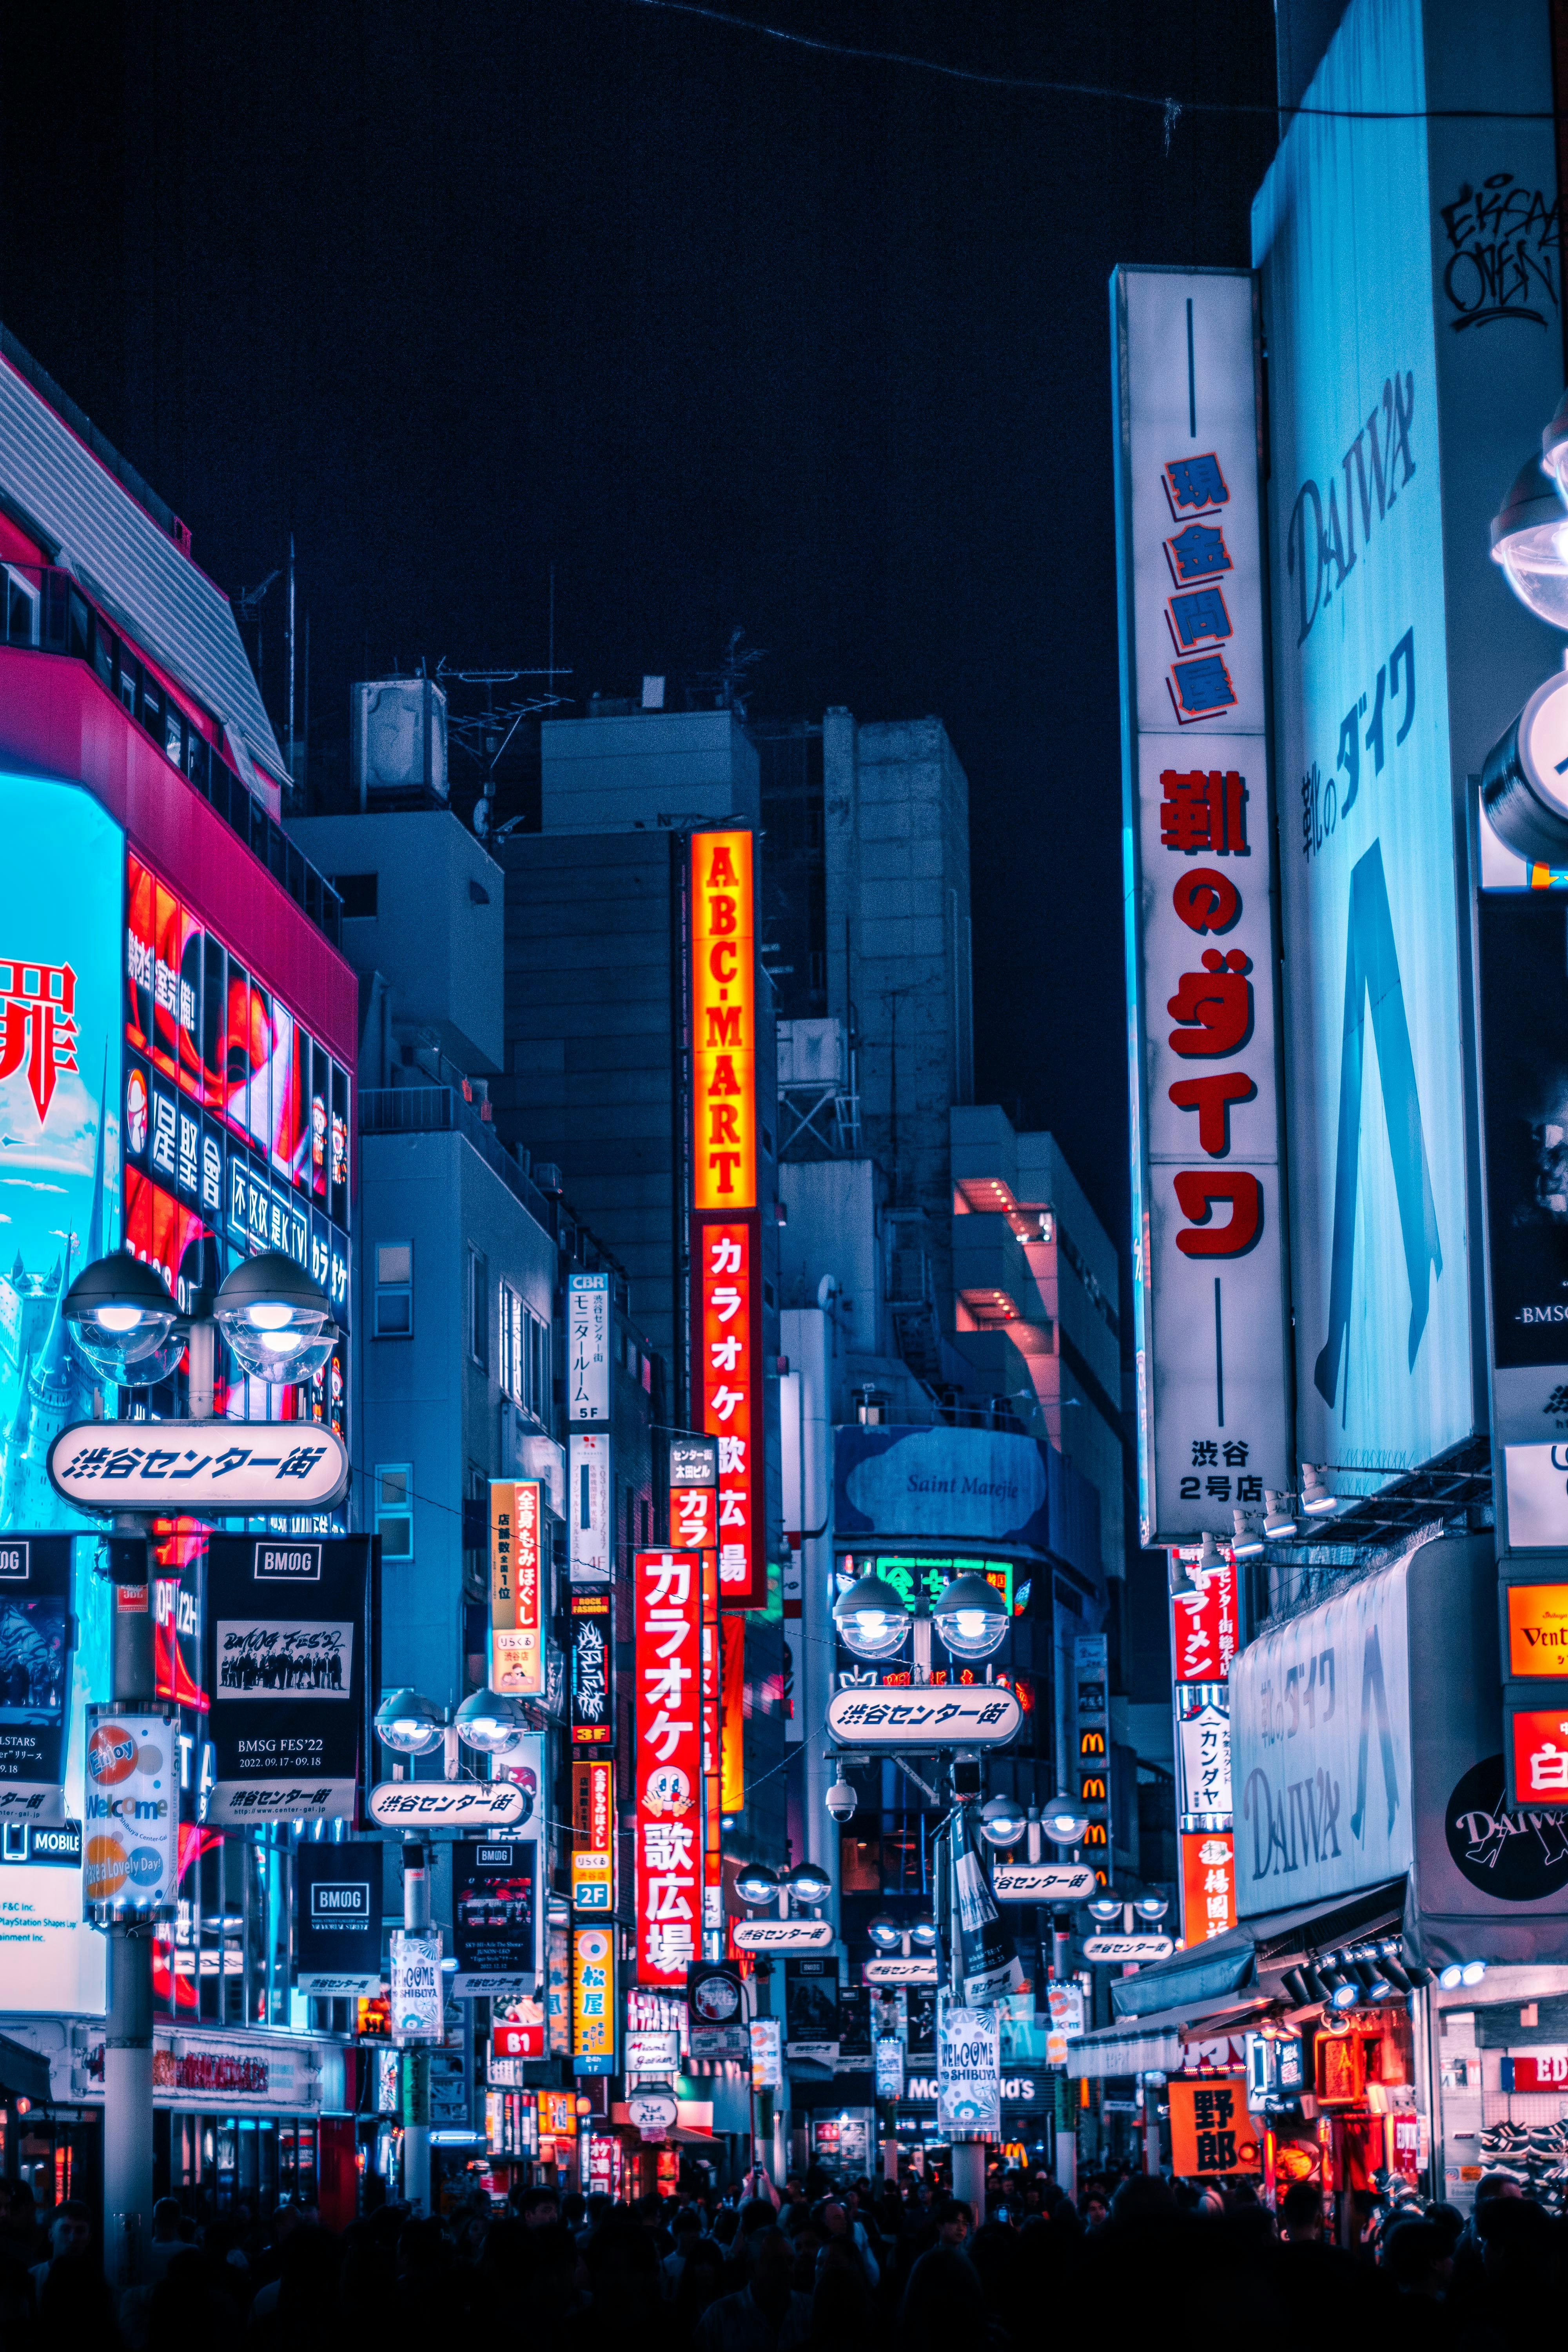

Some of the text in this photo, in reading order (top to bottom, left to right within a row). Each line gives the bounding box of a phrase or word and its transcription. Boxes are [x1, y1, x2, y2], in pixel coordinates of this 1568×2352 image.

[1288, 370, 1416, 649] DAIWA
[1302, 626, 1416, 864] 靴のダイワ
[706, 847, 742, 1194] ABC-MART
[1159, 769, 1264, 1260] 靴のダイワ
[312, 1235, 347, 1303] カラオケ
[573, 1276, 604, 1289] CBR
[593, 1295, 603, 1363] 渋谷センター街
[574, 1295, 590, 1401] モニタールーム
[710, 1238, 747, 1582] カラオケ歌広場
[62, 1446, 327, 1480] 渋谷センター街
[673, 1450, 713, 1461] センター街
[1192, 1440, 1249, 1467] 渋谷
[675, 1464, 711, 1479] 太田ビル
[907, 1474, 956, 1494] Saint
[1180, 1475, 1263, 1502] 2号店
[517, 1490, 536, 1625] 全身もみほぐし
[501, 1637, 532, 1647] りらくる
[504, 1651, 529, 1662] 渋谷店
[1260, 1647, 1334, 1749] 靴のダイワ
[837, 1702, 1011, 1726] 渋谷センター街
[238, 1739, 323, 1753] BMSG FES'22
[576, 1728, 606, 1741] 3F
[88, 1739, 133, 1777] Enjoy
[1201, 1731, 1220, 1805] カンダヤ
[86, 1793, 168, 1820] Welcome
[229, 1788, 332, 1808] 渋谷センター街
[377, 1792, 515, 1812] 渋谷センター街
[119, 1817, 139, 1837] Shibuya
[1243, 1767, 1342, 1881] DAIWA
[35, 1833, 80, 1852] MOBILE
[85, 1857, 162, 1886] Have a Lovely Day!
[22, 1902, 35, 1911] Inc.
[581, 1887, 605, 1904] 2F
[32, 1933, 45, 1942] Inc.
[738, 1927, 827, 1941] 渋谷センター街
[1089, 1942, 1168, 1954] 渋谷センター街
[399, 1989, 438, 1998] SHIBUYA
[581, 1965, 607, 2016] 松屋
[507, 2033, 530, 2053] B1
[941, 2042, 993, 2067] WELCOME
[950, 2069, 997, 2081] SHIBUYA
[1536, 2056, 1568, 2082] ED
[909, 2078, 1035, 2100] Mcld's
[1194, 2089, 1237, 2172] 野郎
